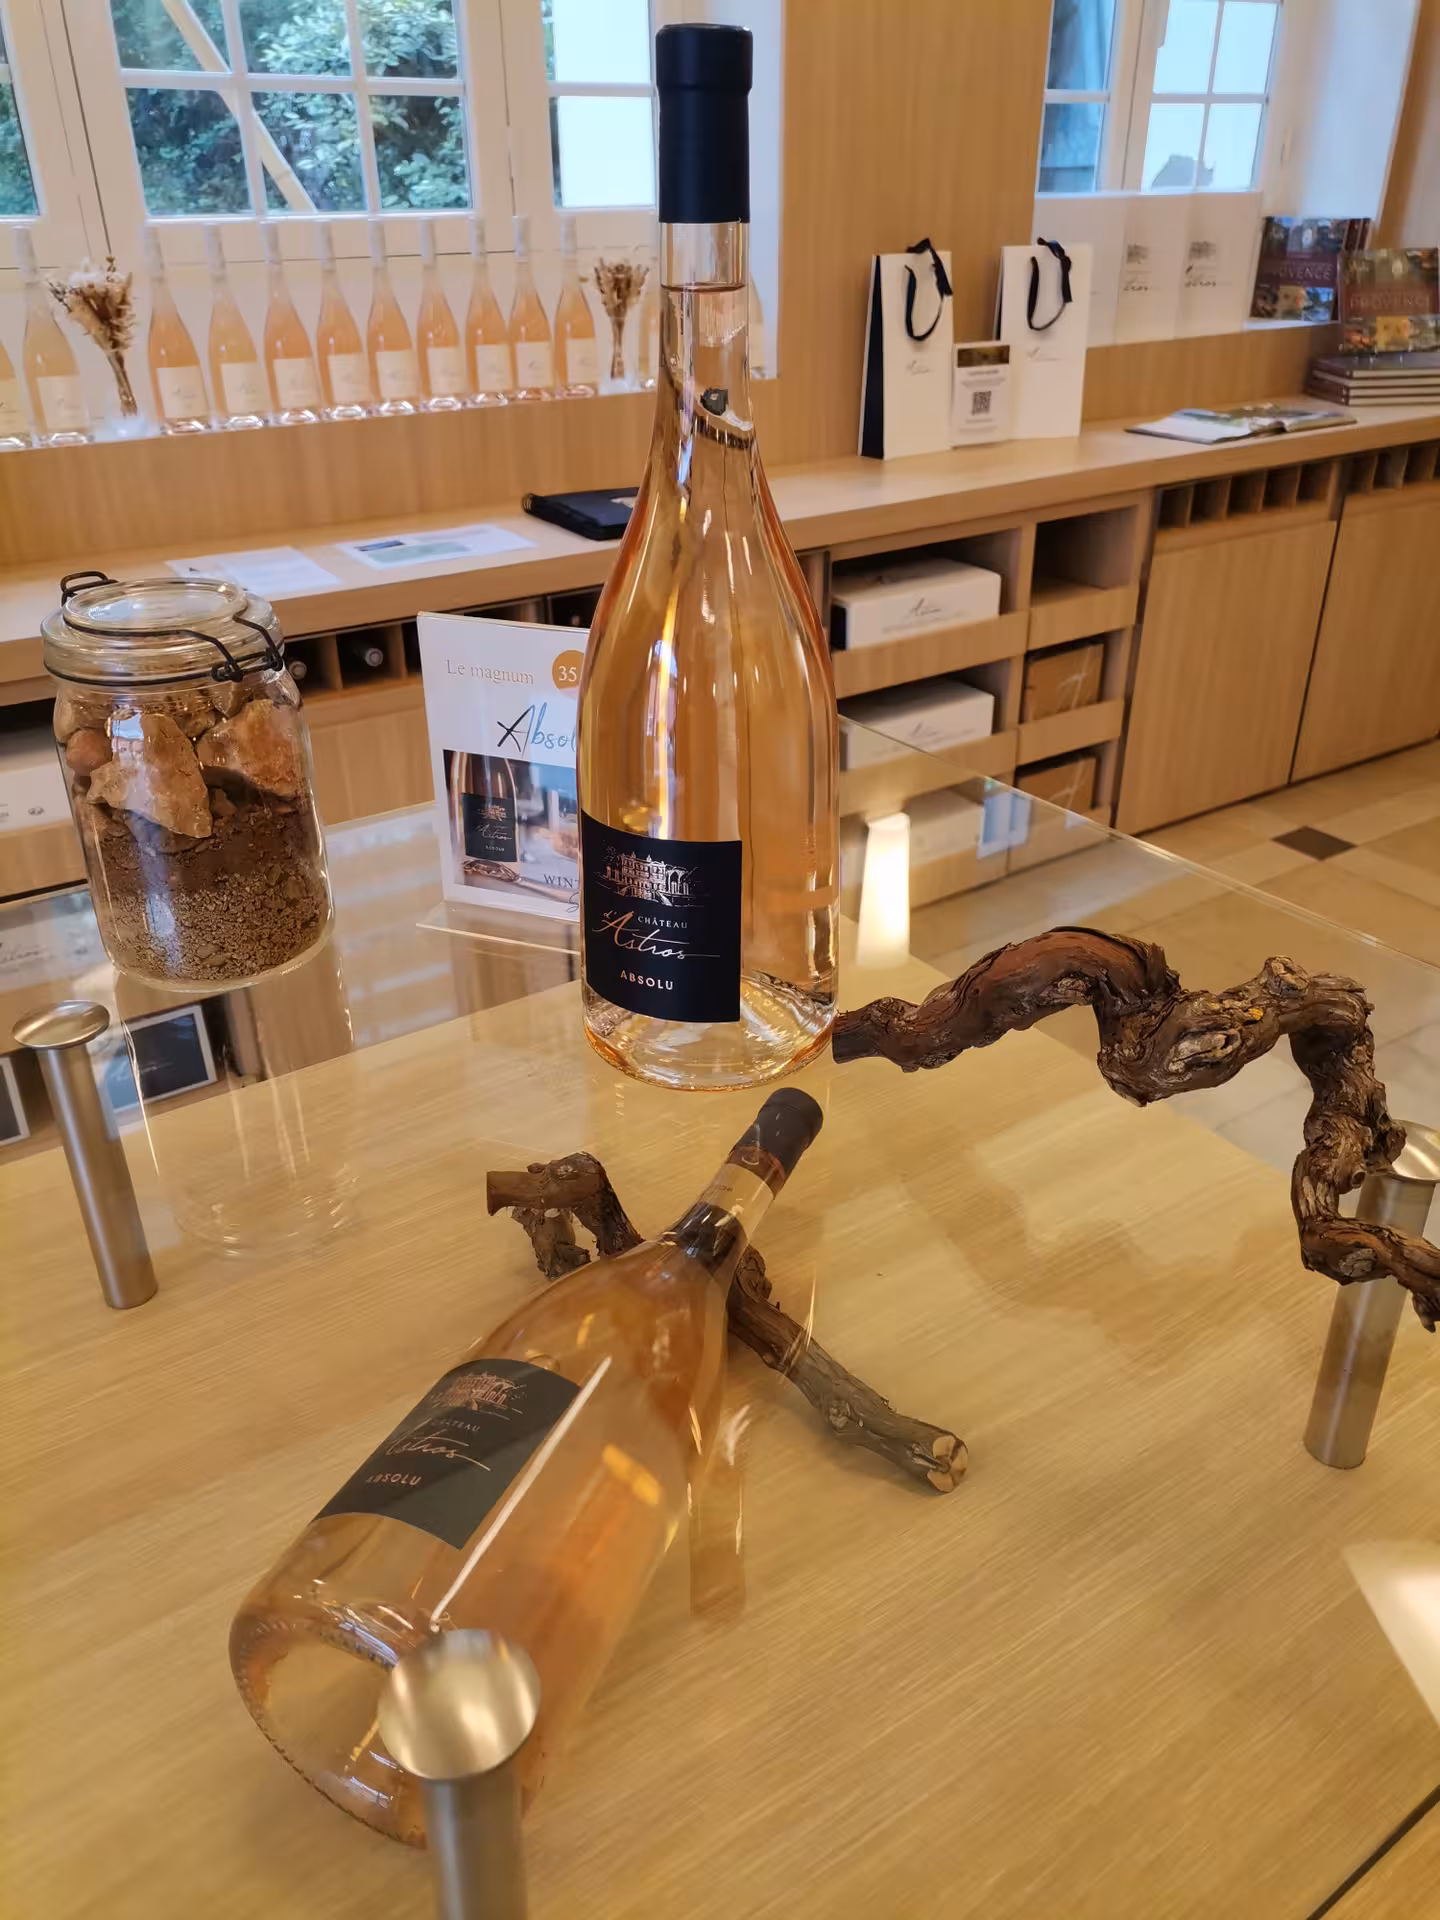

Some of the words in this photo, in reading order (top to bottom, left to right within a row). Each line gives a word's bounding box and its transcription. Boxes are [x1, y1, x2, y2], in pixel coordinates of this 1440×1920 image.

[445, 659, 466, 676] Le
[470, 666, 534, 685] magnum
[558, 665, 578, 683] 35
[543, 873, 579, 888] WIN
[637, 915, 688, 929] CHÂTEAU
[620, 969, 674, 991] ABSOLU
